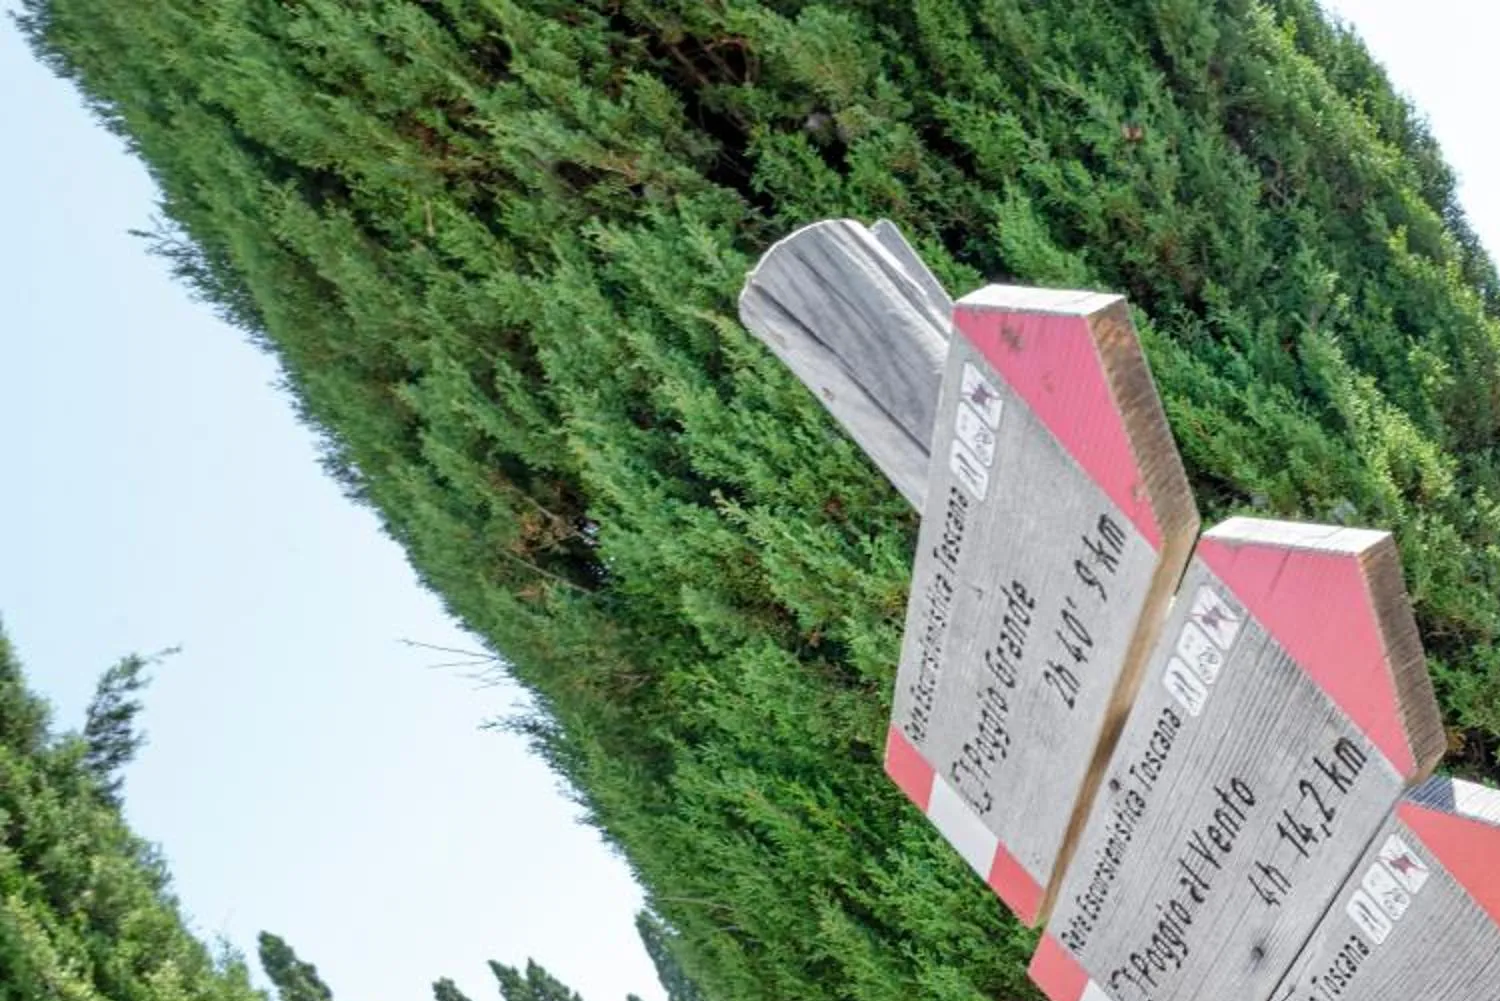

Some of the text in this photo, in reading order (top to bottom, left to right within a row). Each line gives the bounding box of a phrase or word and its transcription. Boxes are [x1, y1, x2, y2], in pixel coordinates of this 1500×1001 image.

[963, 578, 1035, 779] Poggio Grande
[1043, 660, 1081, 710] 2h
[1081, 513, 1127, 575] km
[1061, 914, 1087, 954] Rete
[1129, 706, 1182, 790] Toscana
[1125, 775, 1257, 989] Poggio al Vento
[1247, 736, 1369, 909] 4h 14,2 km
[1311, 934, 1370, 998] Toscana
